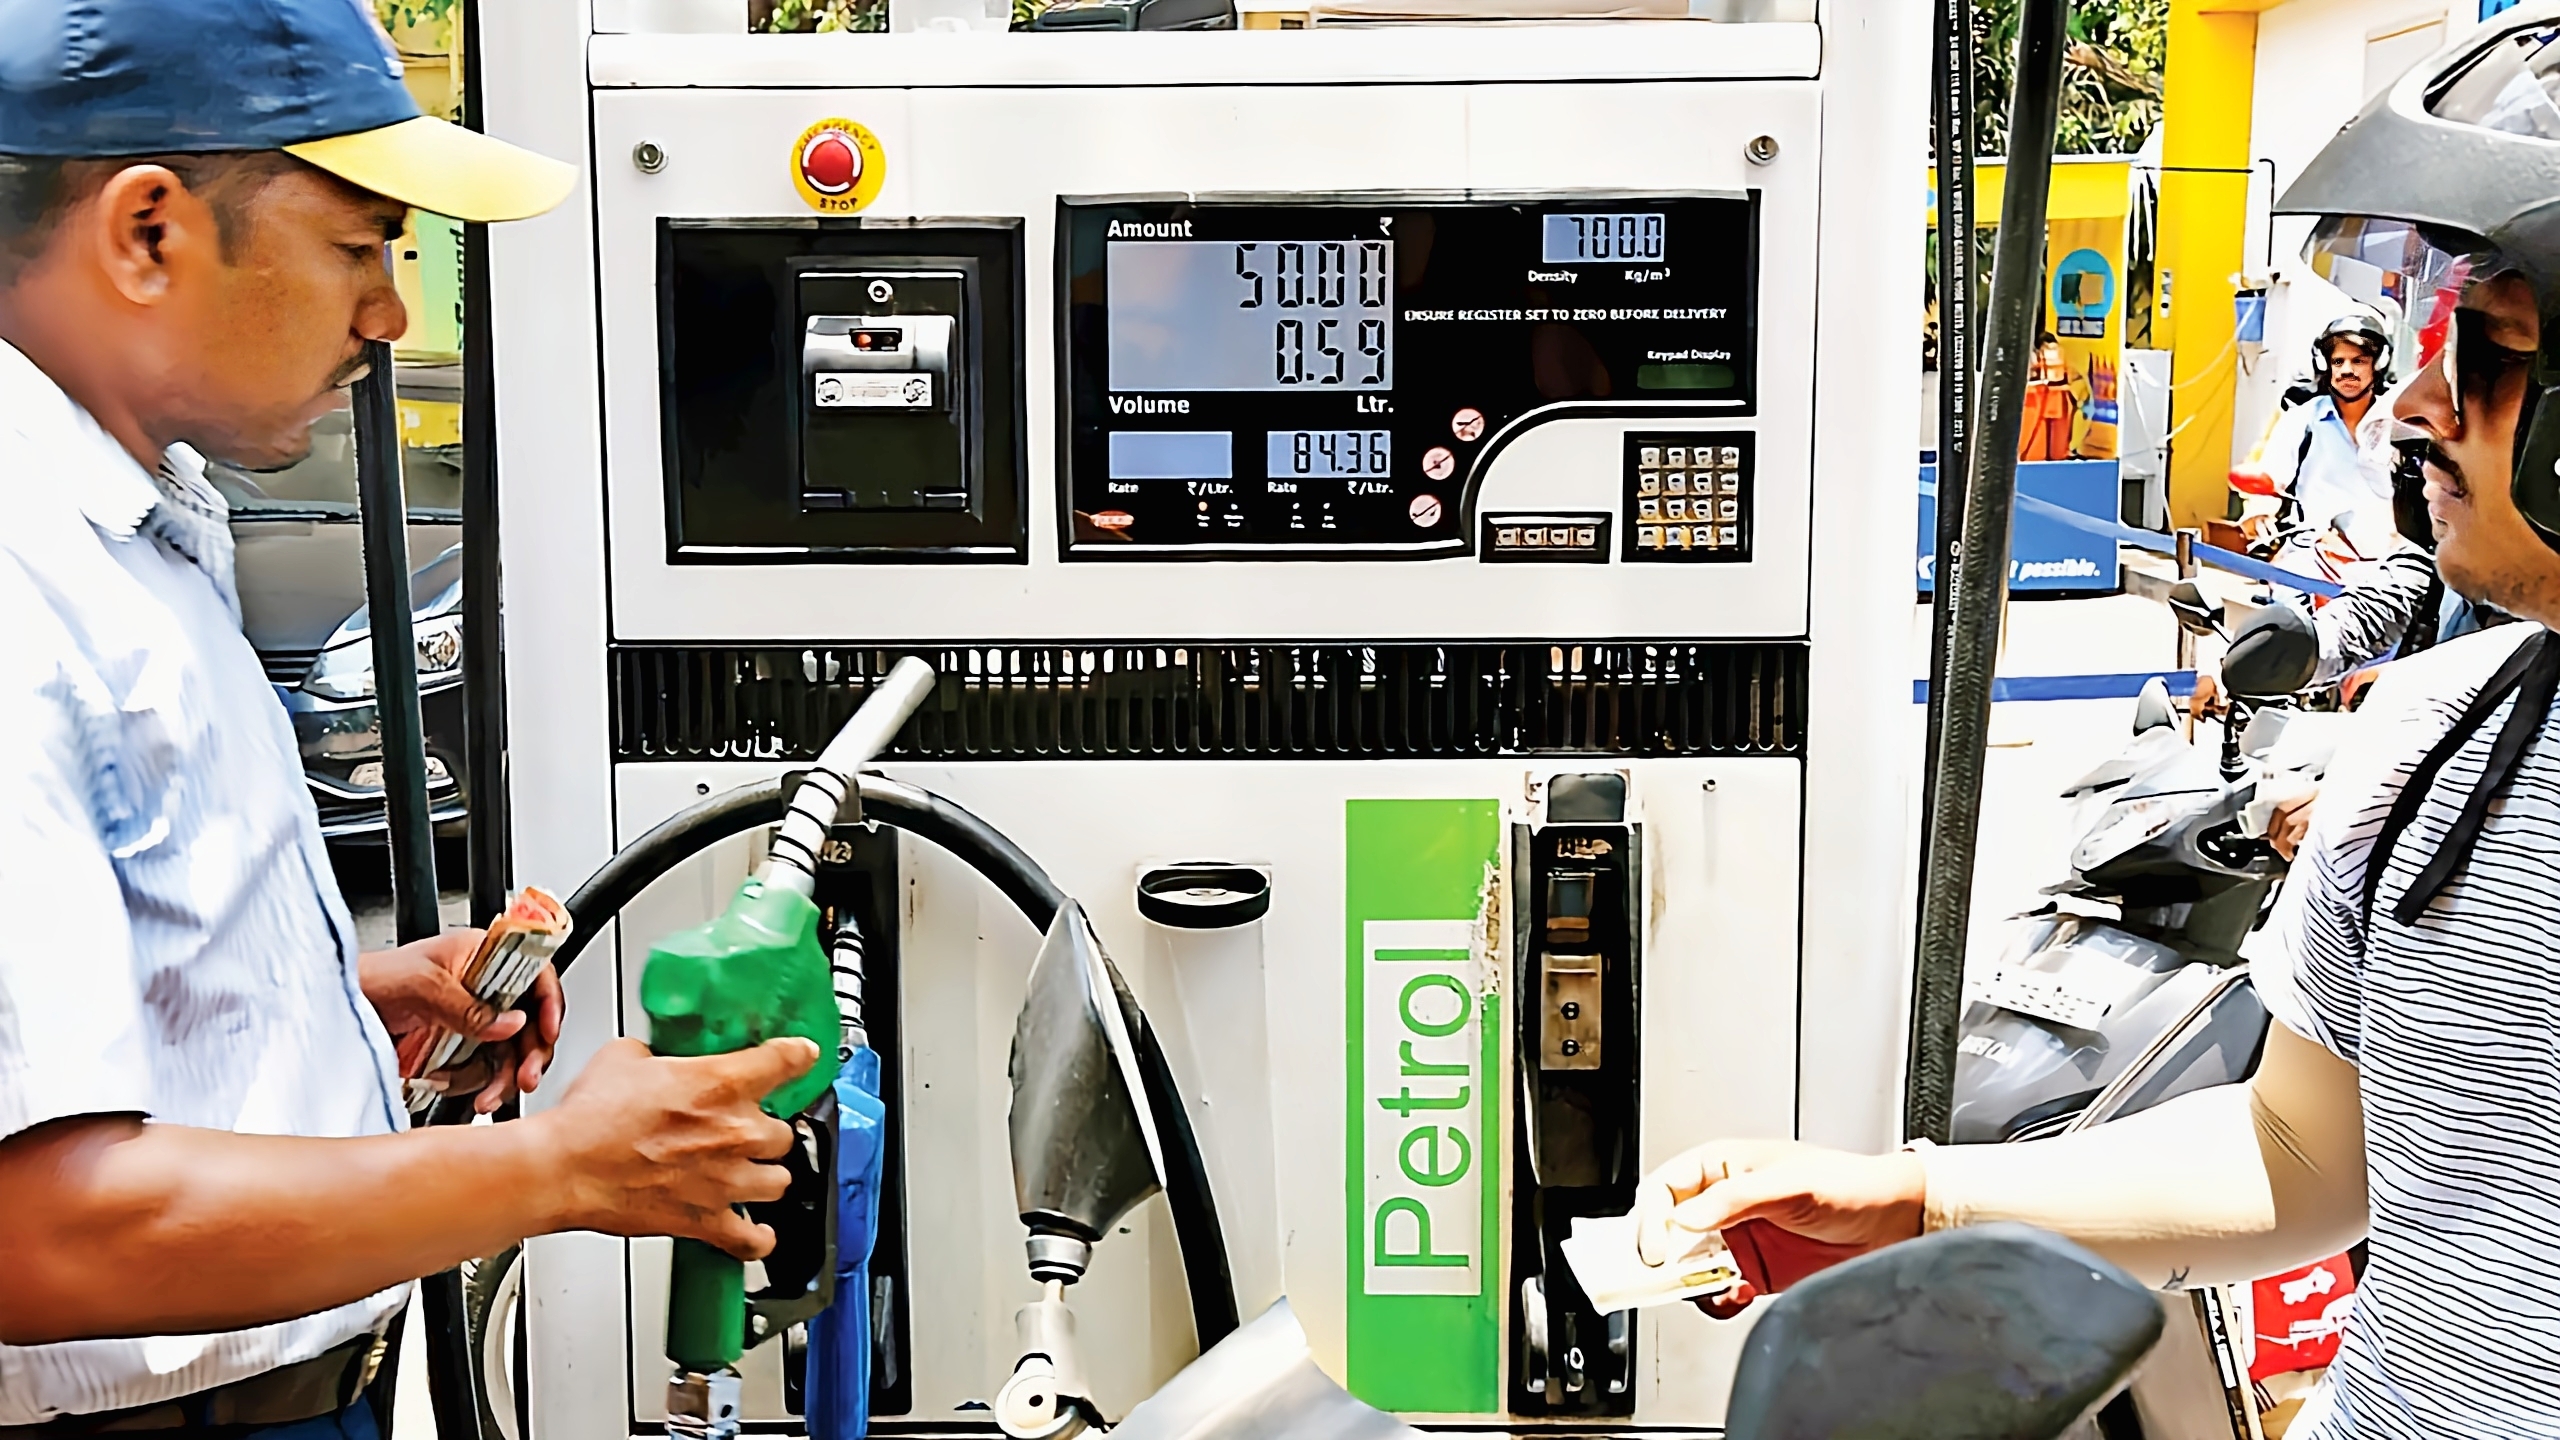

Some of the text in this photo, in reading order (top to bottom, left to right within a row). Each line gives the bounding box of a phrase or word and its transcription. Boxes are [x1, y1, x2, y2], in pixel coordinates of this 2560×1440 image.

[819, 196, 859, 211] STOP
[1107, 219, 1193, 238] Amount
[1568, 216, 1662, 259] 700.0
[1236, 243, 1386, 309] 50.00
[1527, 269, 1578, 284] Density
[1404, 307, 1727, 322] ENSURE REGISTER SET TO ZERO BEFORE DELIVERY
[1276, 319, 1386, 385] 0.59
[1647, 348, 1731, 362] Keypad Display
[1108, 395, 1190, 415] Volume
[1356, 394, 1394, 414] Ltr.
[1293, 432, 1387, 474] 84.36
[1108, 481, 1139, 494] Rate
[1267, 481, 1298, 494] Rate
[2018, 558, 2101, 582] possible.
[1374, 949, 1471, 1266] Petrol
